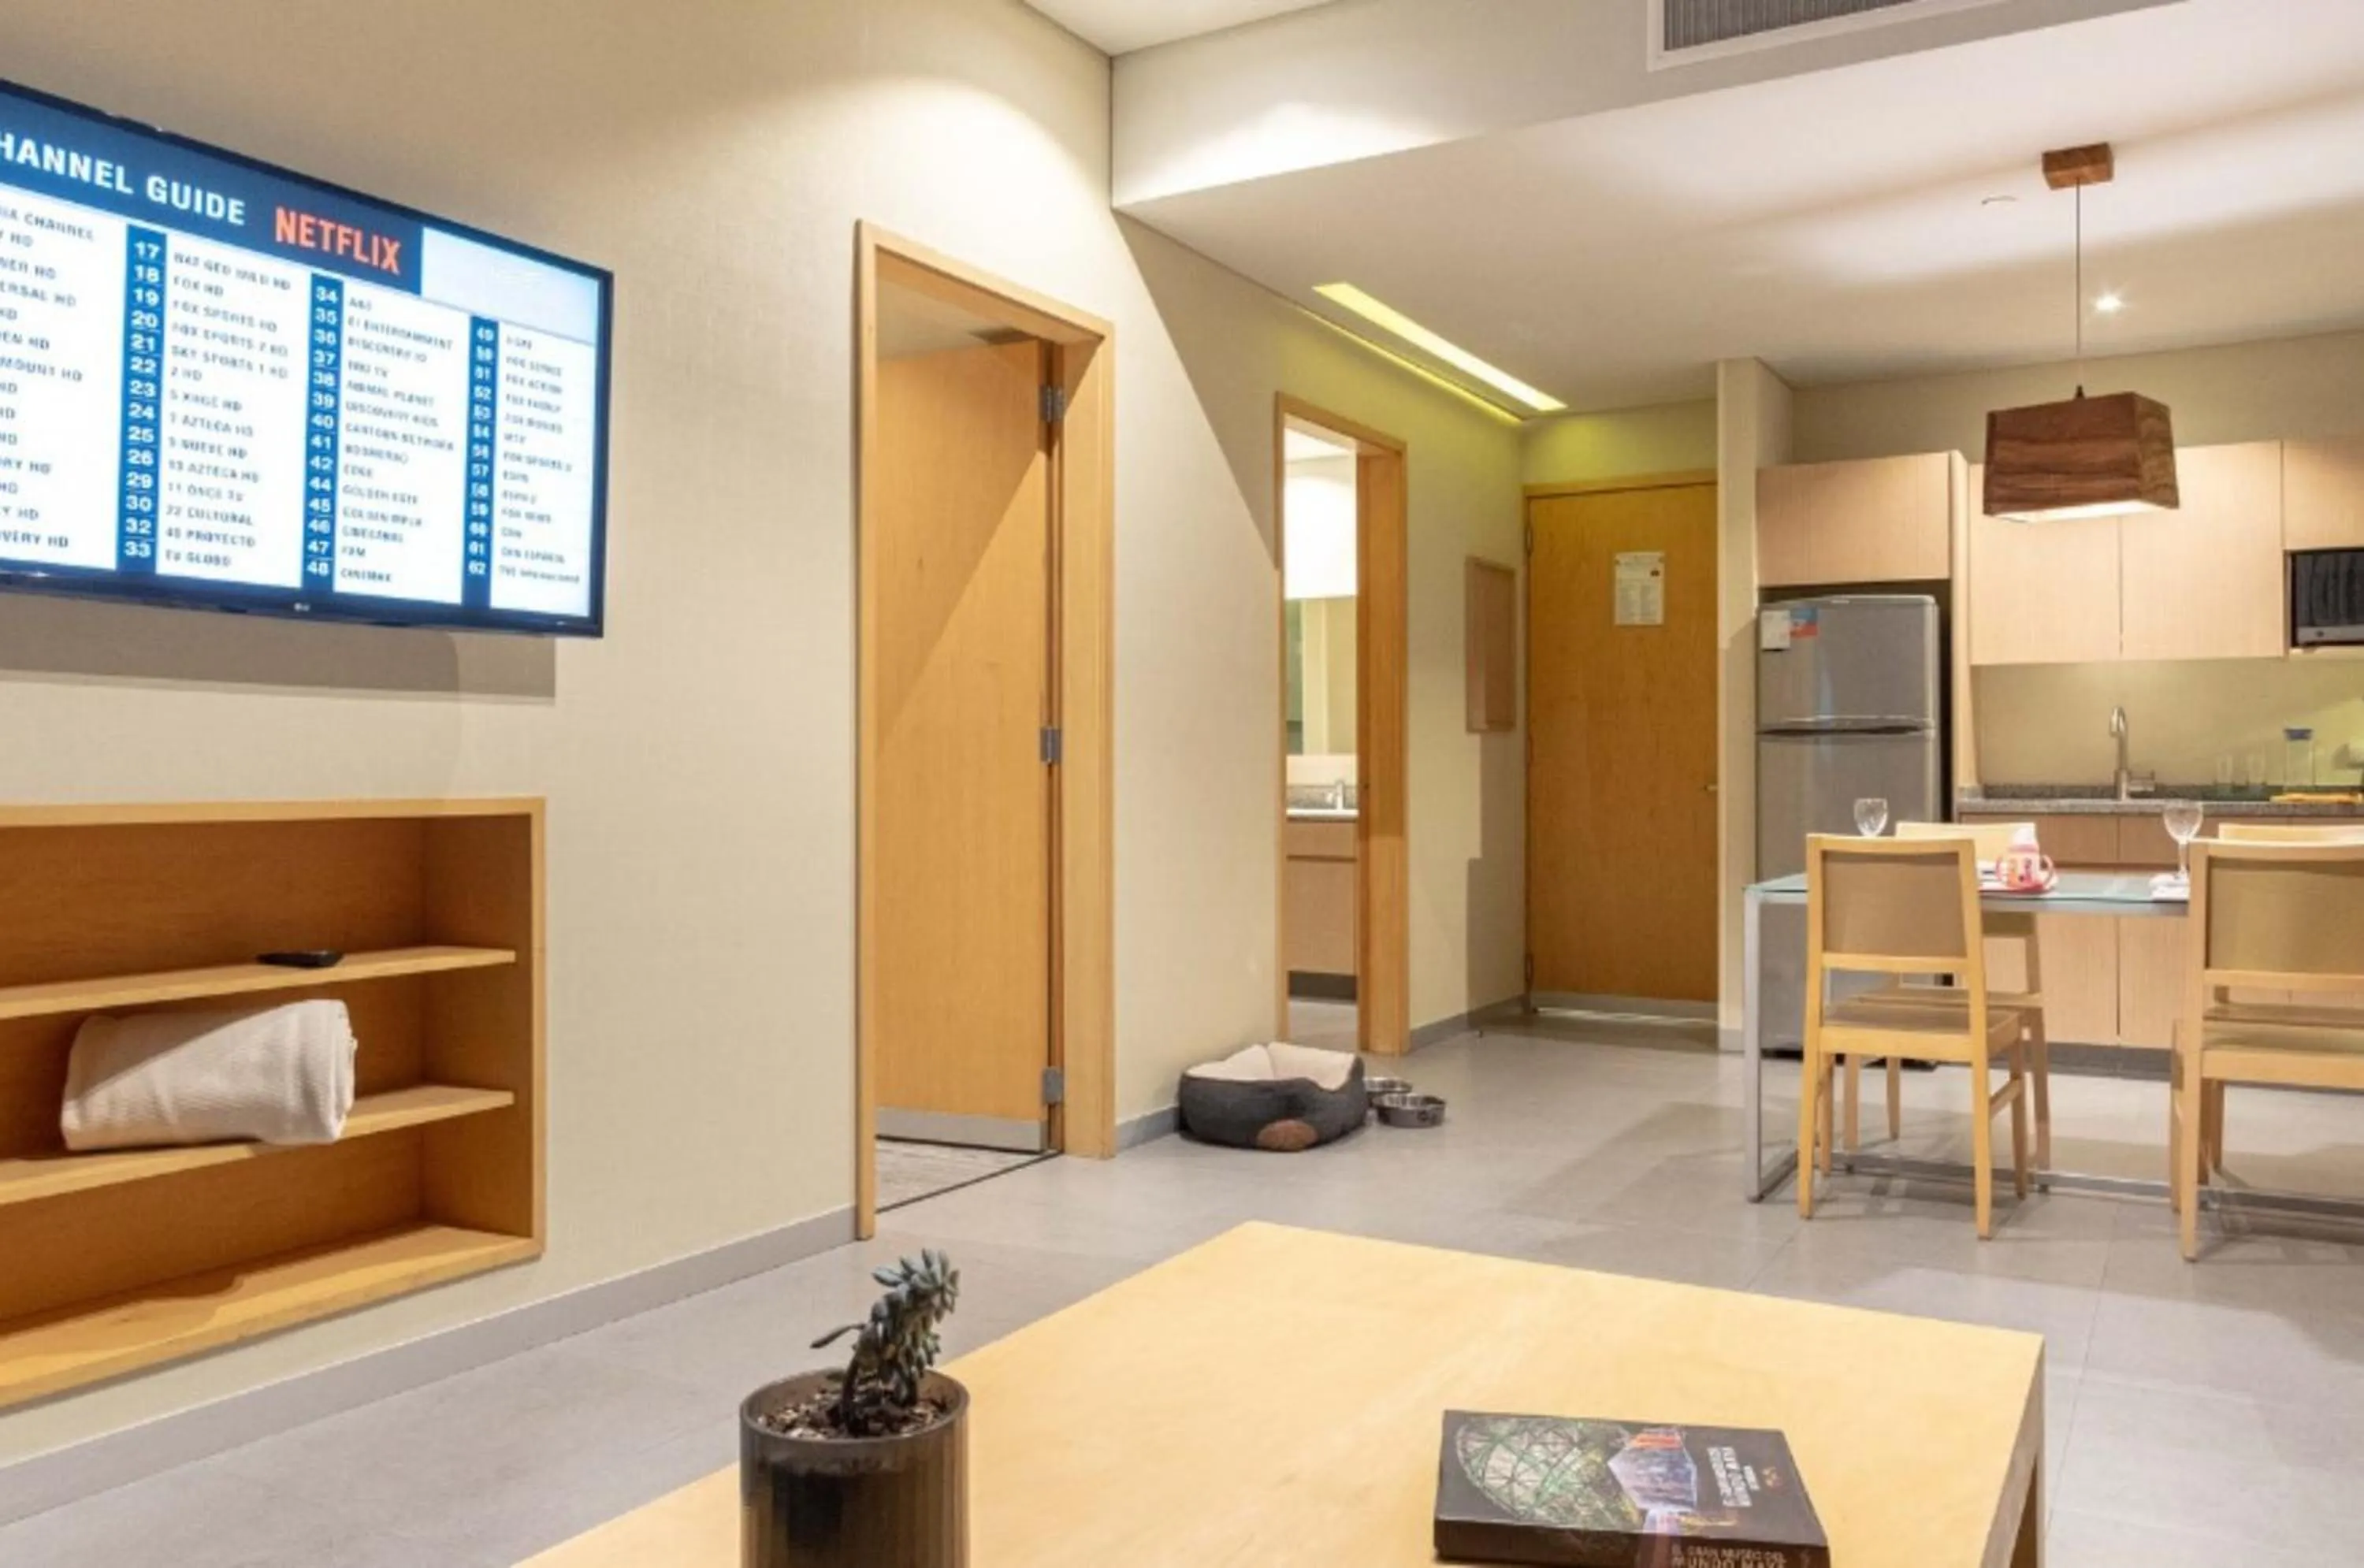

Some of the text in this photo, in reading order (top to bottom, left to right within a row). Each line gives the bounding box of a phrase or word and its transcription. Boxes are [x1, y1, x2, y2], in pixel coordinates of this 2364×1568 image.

[147, 175, 246, 225] GUIDE
[274, 205, 402, 276] NETFLIX
[135, 240, 160, 259] 17
[135, 264, 160, 283] 18
[134, 287, 160, 307] 19
[315, 285, 338, 303] 34
[131, 310, 158, 329] 20
[315, 306, 337, 325] 35
[130, 333, 155, 352] 21
[130, 355, 156, 375] 22
[314, 349, 336, 366] 37
[313, 370, 336, 387] 38
[129, 378, 156, 398] 23
[128, 401, 154, 421] 24
[311, 412, 334, 429] 40
[128, 425, 154, 444] 25
[310, 433, 332, 451] 41
[127, 448, 154, 466] 26
[310, 455, 333, 471] 42
[309, 476, 332, 492] 44
[125, 494, 153, 513] 30
[309, 497, 330, 512] 45
[125, 516, 152, 534] 32
[125, 541, 151, 559] 33
[307, 539, 330, 555] 47
[306, 560, 329, 577] 48
